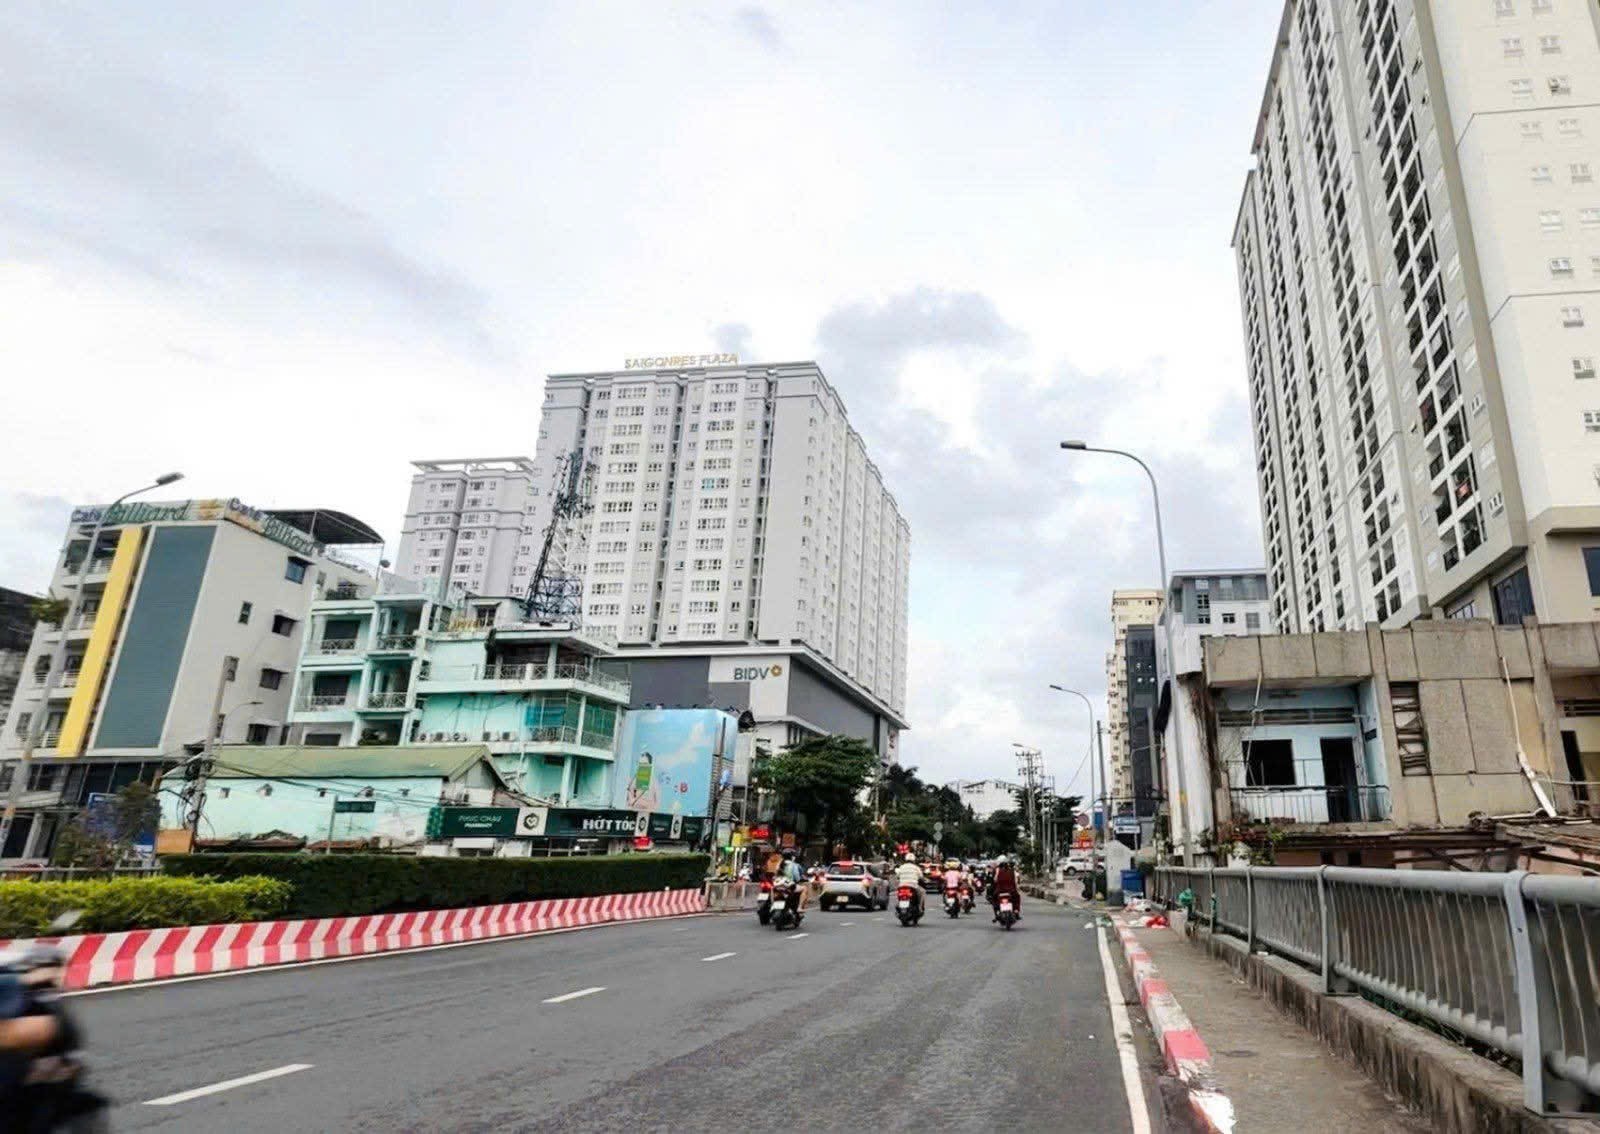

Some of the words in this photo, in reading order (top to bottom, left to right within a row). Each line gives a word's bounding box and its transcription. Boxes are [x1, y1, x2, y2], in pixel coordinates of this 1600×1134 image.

[624, 355, 697, 369] SAIGONRES
[699, 353, 738, 366] PLAZA
[734, 667, 770, 681] BIDV
